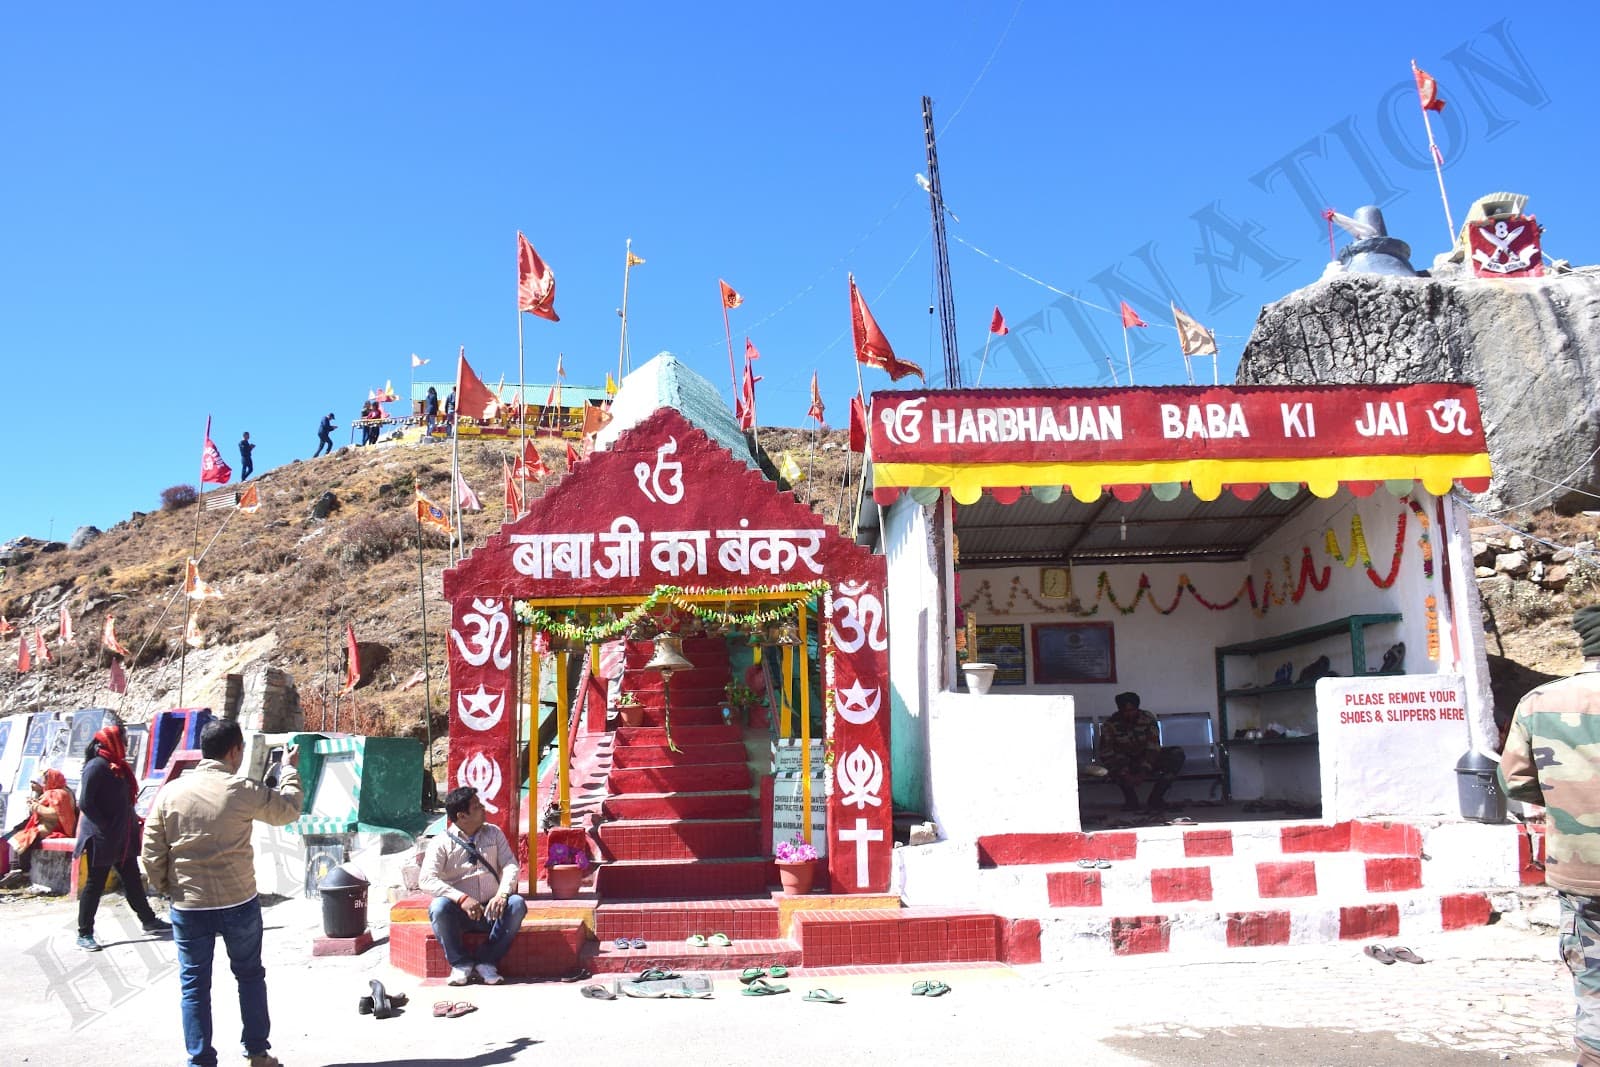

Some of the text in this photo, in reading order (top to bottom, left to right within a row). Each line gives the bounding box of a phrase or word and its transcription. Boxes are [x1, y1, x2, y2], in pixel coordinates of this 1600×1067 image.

[933, 401, 1409, 444] HARBHAJAN BABA KI JAI
[510, 516, 825, 579] बाबा जी का बंकर
[1345, 690, 1456, 706] PLEASE REMOVE YOUR
[1340, 708, 1465, 724] SHOES & SLIPPERS HERE
